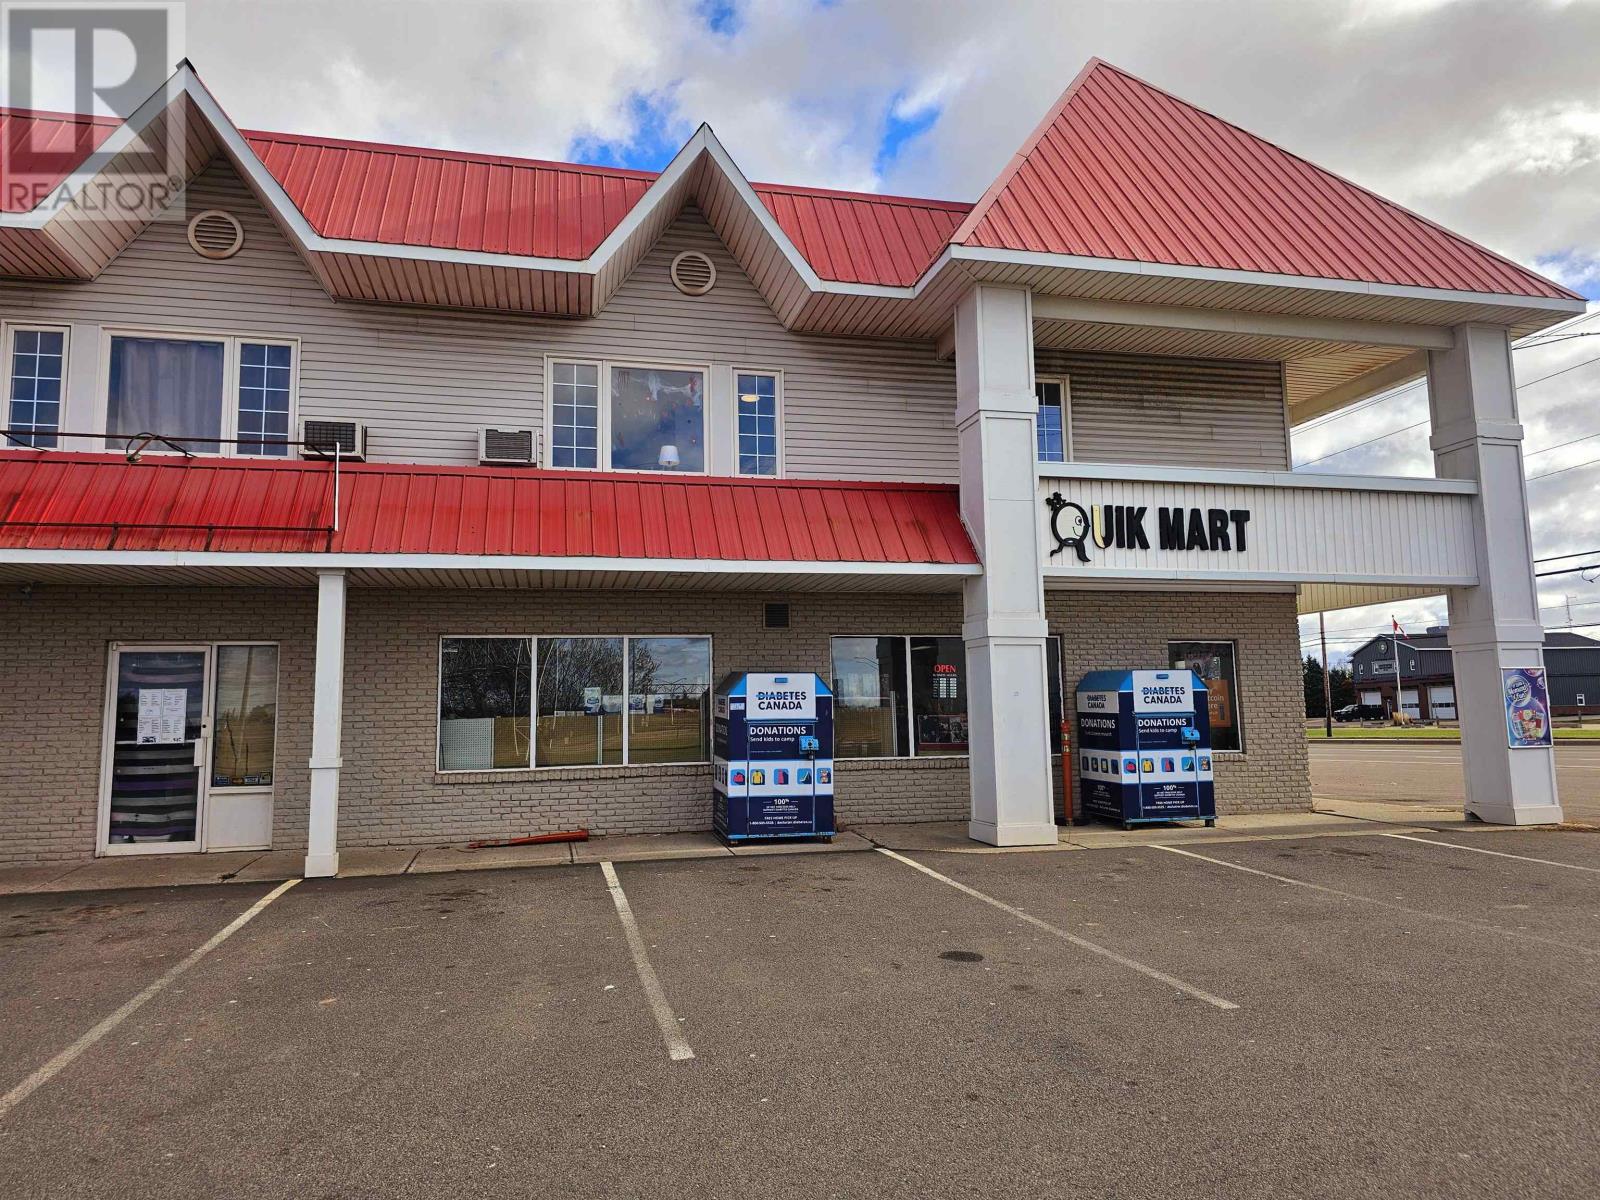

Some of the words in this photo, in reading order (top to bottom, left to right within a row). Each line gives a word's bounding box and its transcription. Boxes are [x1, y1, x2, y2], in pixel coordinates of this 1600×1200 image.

[1158, 506, 1251, 552] MART
[934, 664, 957, 673] OPEN
[757, 691, 807, 701] DIABETES
[1142, 686, 1186, 696] DIABETES
[1143, 695, 1183, 704] CANADA
[758, 701, 803, 711] CANADA
[1080, 718, 1116, 729] DONATIONS
[1138, 718, 1187, 727] DONATIONS
[750, 726, 807, 735] DONATIONS
